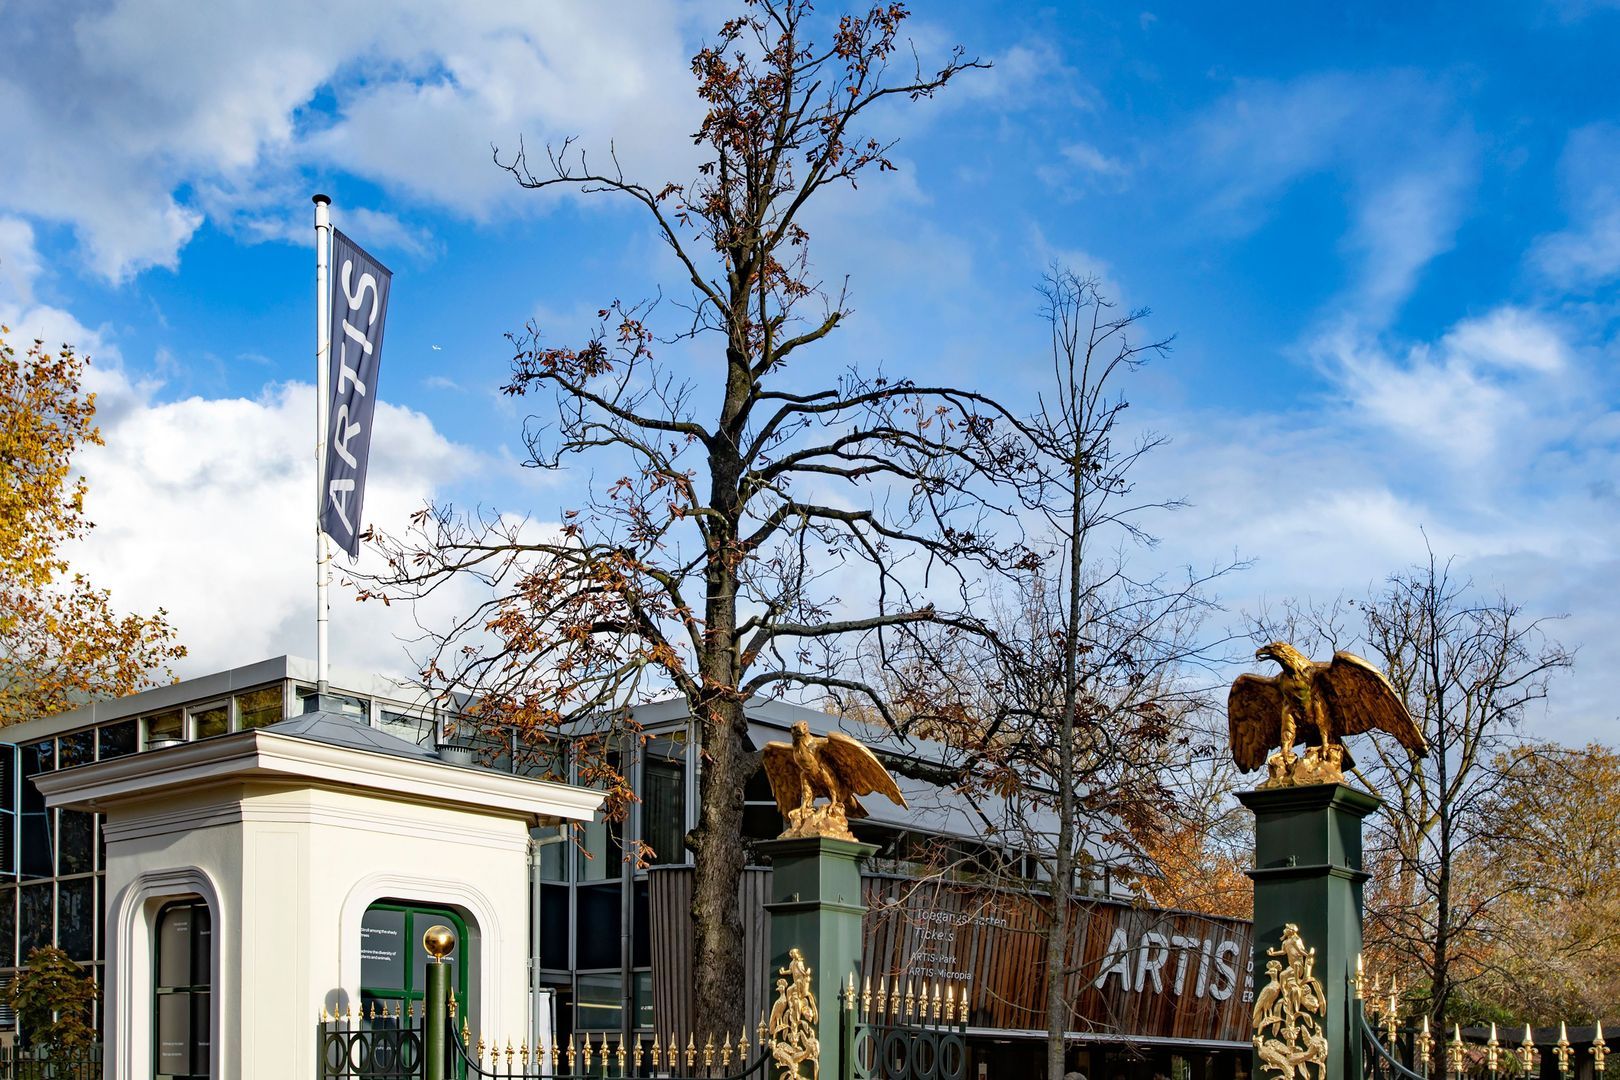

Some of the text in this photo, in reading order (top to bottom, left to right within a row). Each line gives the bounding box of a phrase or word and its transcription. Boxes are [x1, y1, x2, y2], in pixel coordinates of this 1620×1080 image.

[330, 259, 380, 537] ARTIS
[915, 927, 955, 942] Tickets
[1094, 928, 1240, 1001] ARTIS
